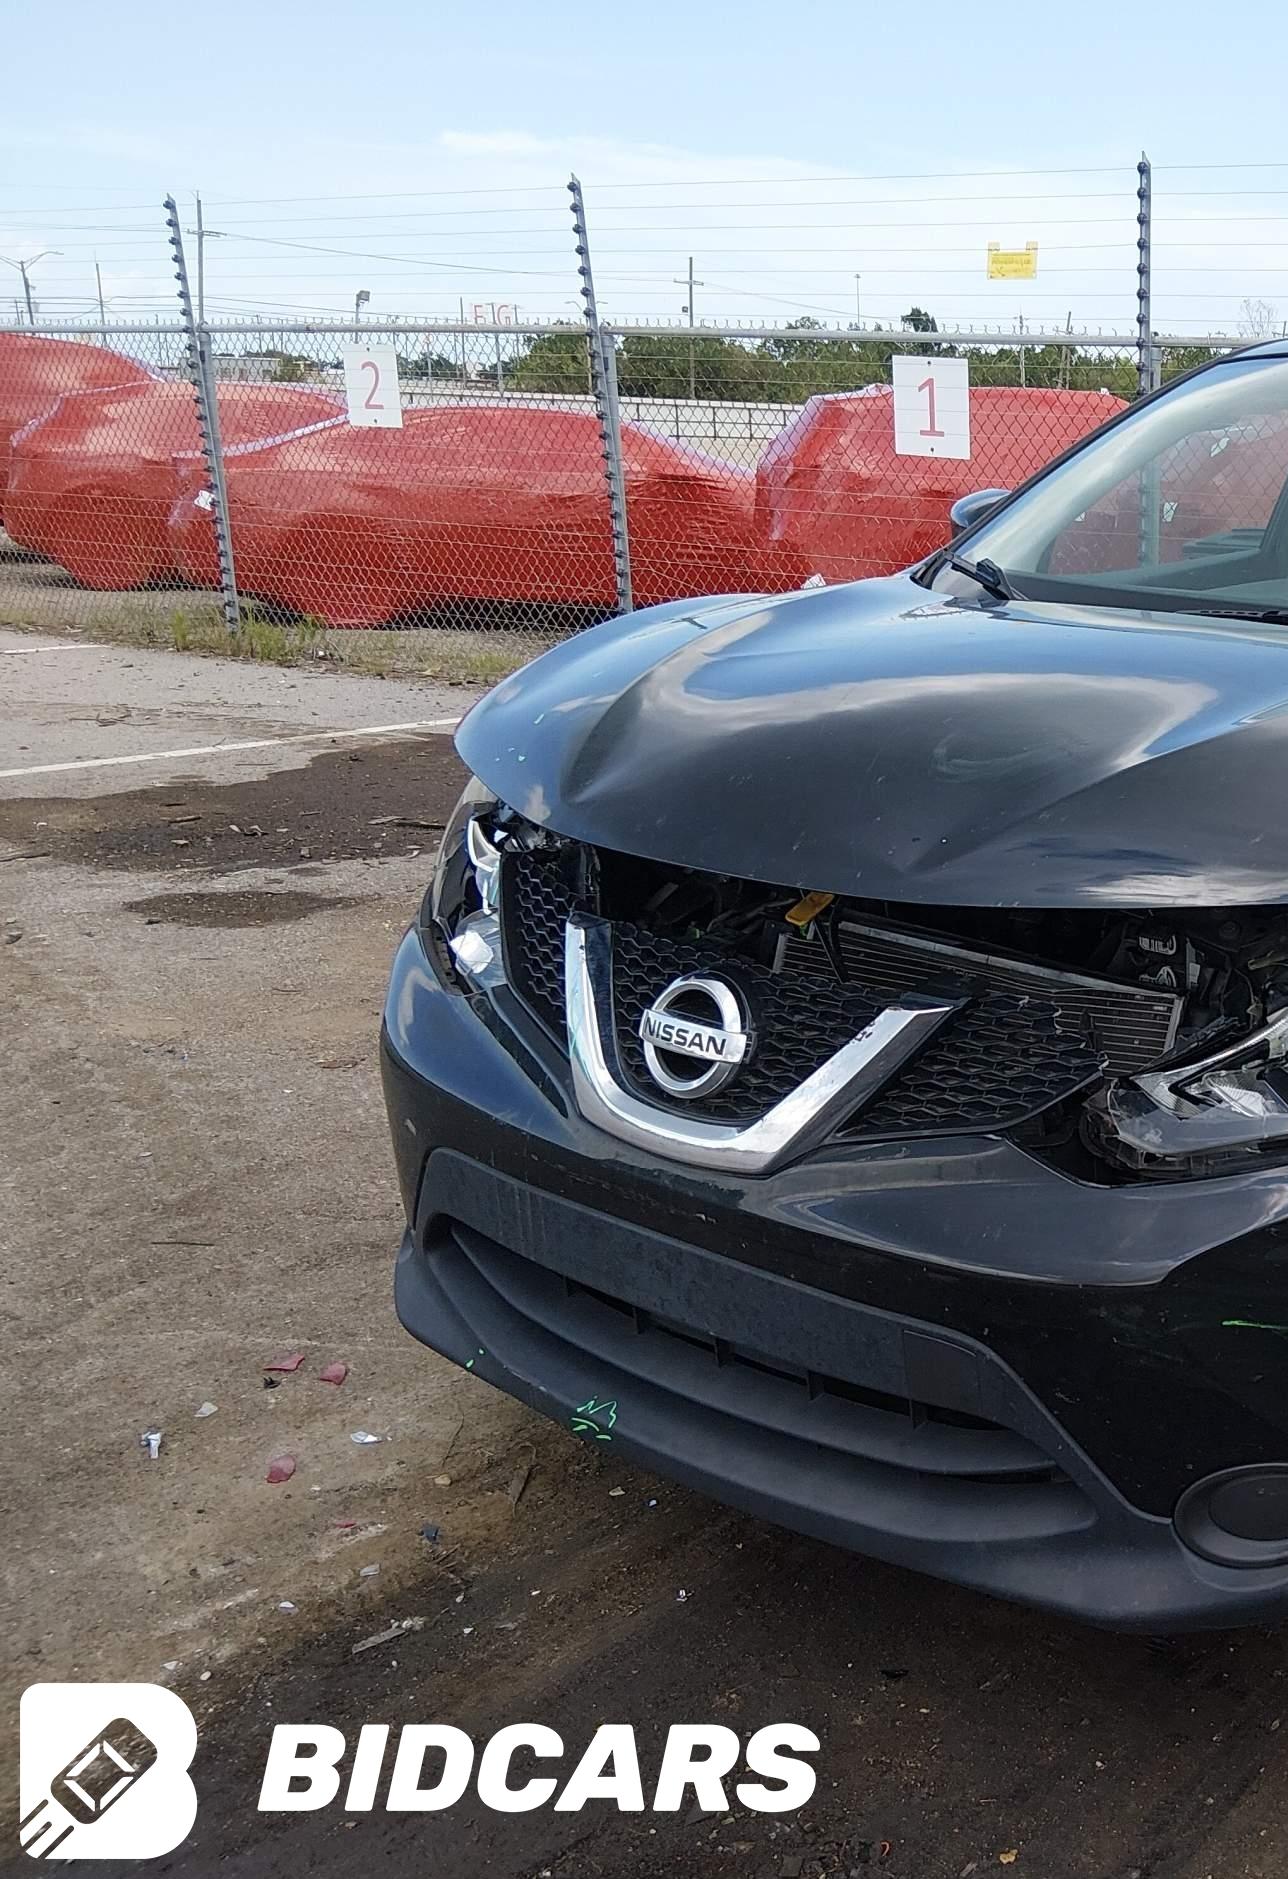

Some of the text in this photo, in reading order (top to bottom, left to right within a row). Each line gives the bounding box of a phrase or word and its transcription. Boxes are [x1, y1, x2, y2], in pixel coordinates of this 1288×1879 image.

[360, 360, 384, 409] 2
[918, 377, 945, 437] 1
[643, 1016, 727, 1056] NISSAN
